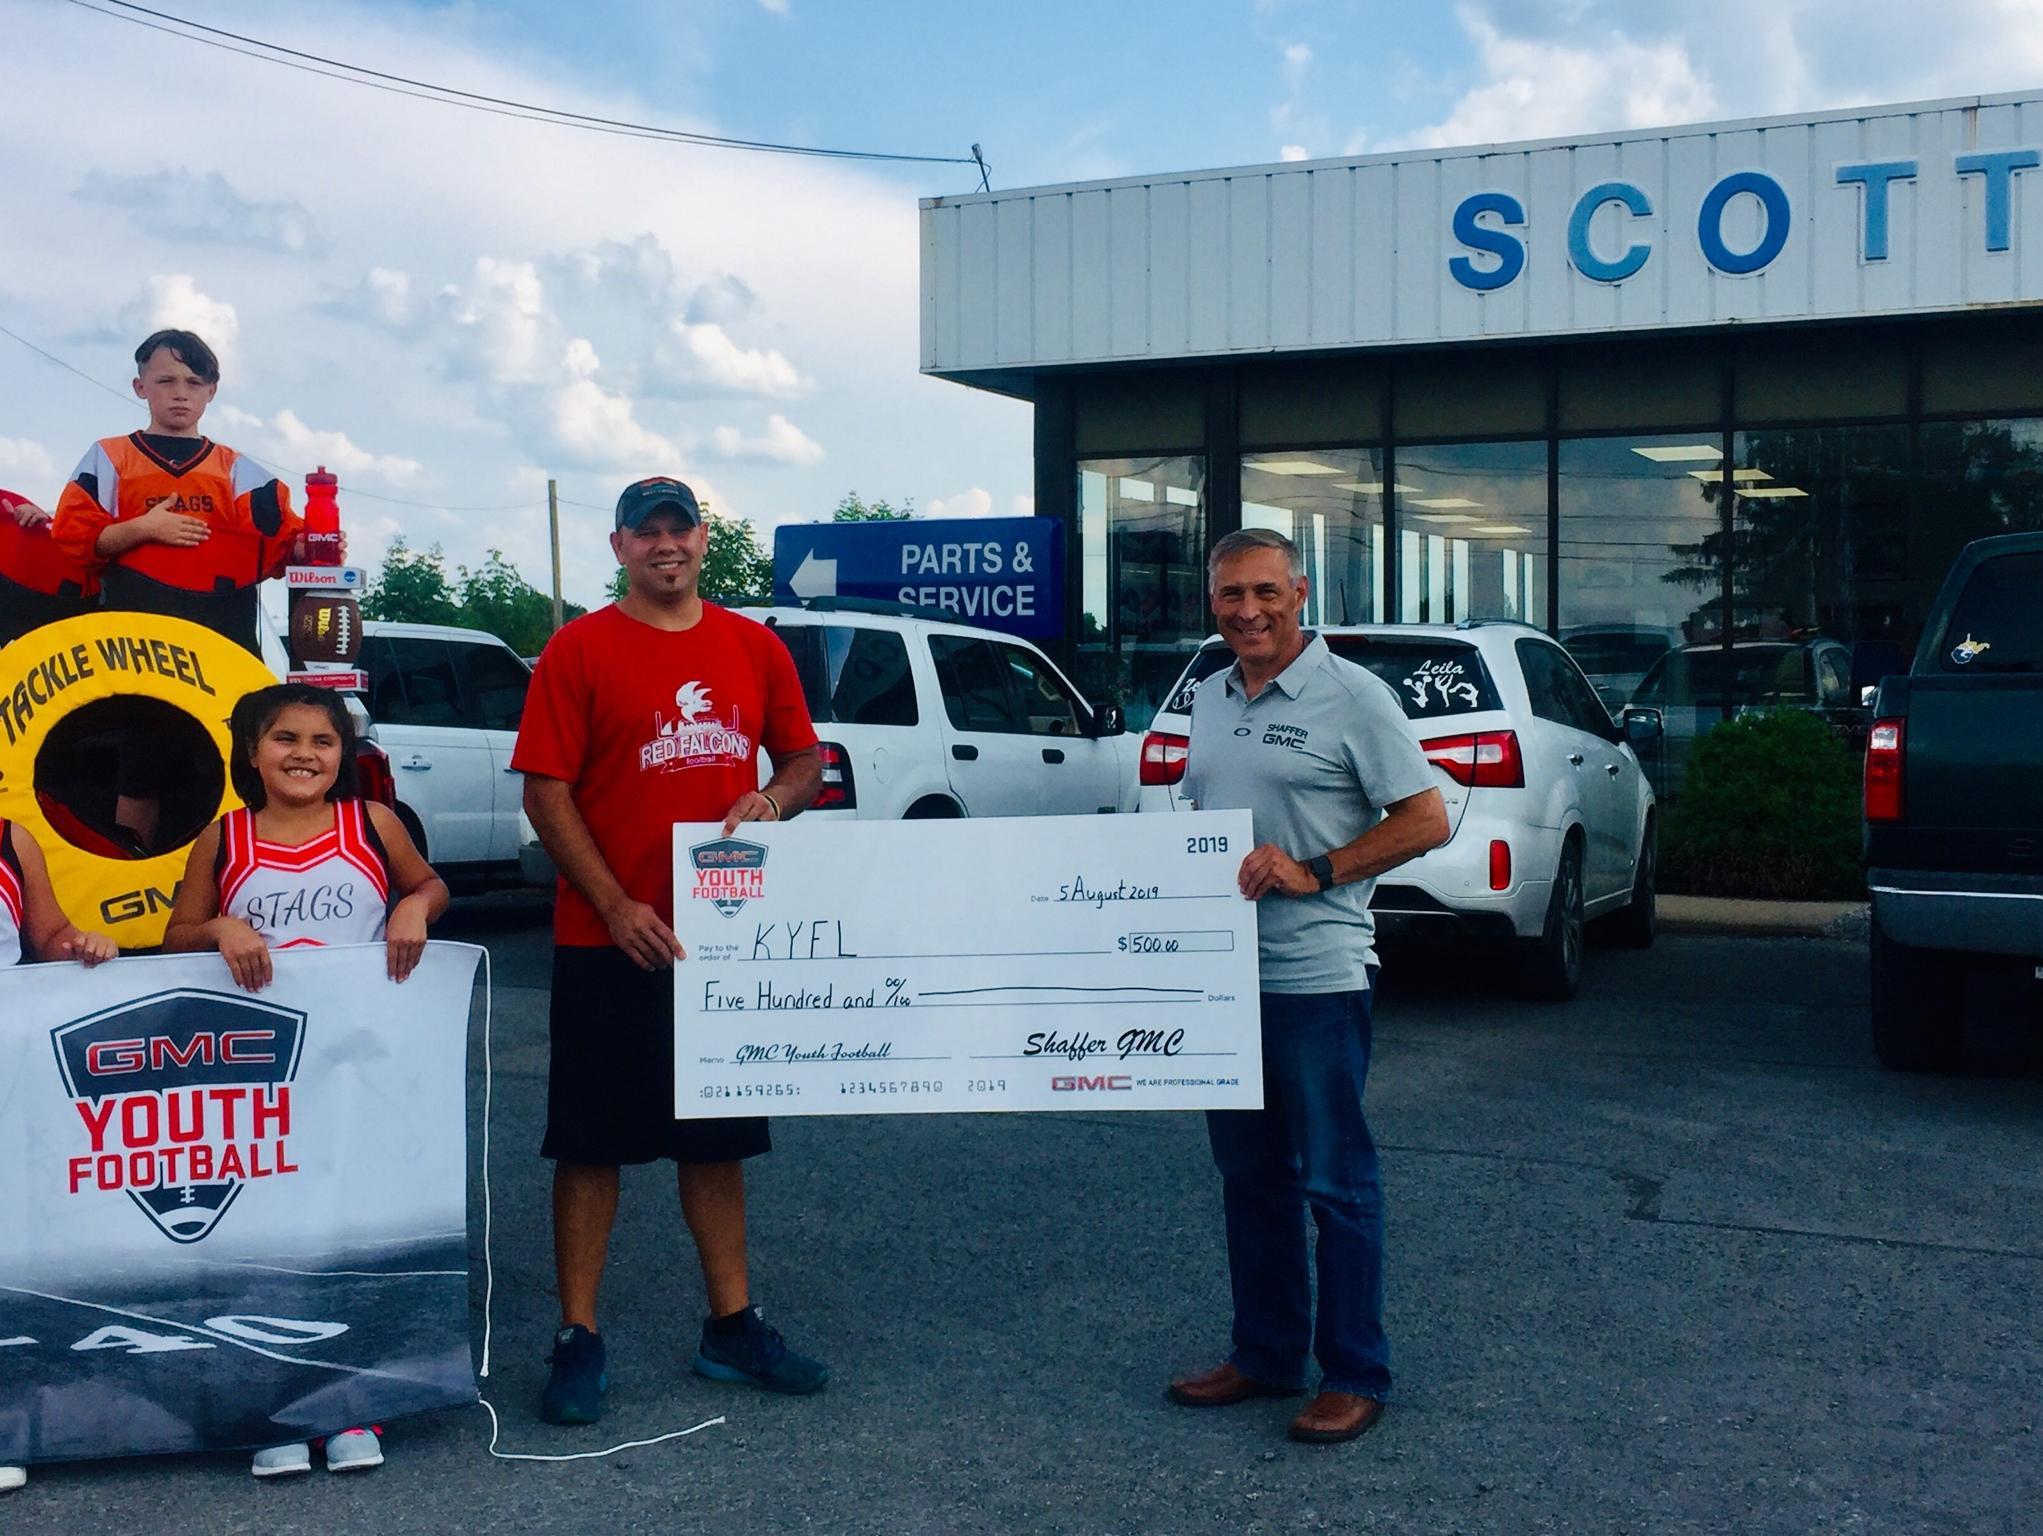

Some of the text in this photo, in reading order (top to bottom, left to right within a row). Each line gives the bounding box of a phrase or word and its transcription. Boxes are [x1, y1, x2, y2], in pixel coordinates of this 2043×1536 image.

[1449, 150, 2040, 290] SCOTT
[145, 495, 214, 512] SAGS
[308, 533, 338, 542] GMC
[902, 541, 1034, 574] PARTS &
[289, 571, 336, 584] Wilson
[1413, 659, 1464, 676] Leila
[0, 637, 216, 747] TACKLE WHEEL
[1262, 733, 1306, 750] GMC
[1266, 723, 1309, 740] SHAFFER
[640, 732, 750, 769] RED FALCONS
[1187, 836, 1228, 853] 2019
[698, 851, 760, 864] GMC
[696, 869, 763, 886] YOUTH
[100, 880, 184, 924] GM
[692, 887, 765, 899] FOOTBALL
[1060, 875, 1159, 909] 5 August 2019
[246, 883, 354, 931] STAGS
[699, 944, 714, 952] Pay
[753, 920, 857, 960] KYFL
[722, 953, 732, 961] of
[705, 980, 745, 1010] Five
[757, 980, 833, 1010] Hundred
[843, 988, 875, 1009] and
[1208, 994, 1235, 1002] Dollars
[86, 1030, 276, 1077] GMC
[736, 1042, 892, 1066] GMC Youth Football
[1023, 1028, 1184, 1061] Shaffer GMC
[1051, 1075, 1132, 1091] GMC
[1163, 1078, 1214, 1086] PROFESSIONAL
[1216, 1078, 1239, 1086] GRADE
[76, 1087, 290, 1152] YOUTH
[68, 1140, 299, 1194] FOOTBALL
